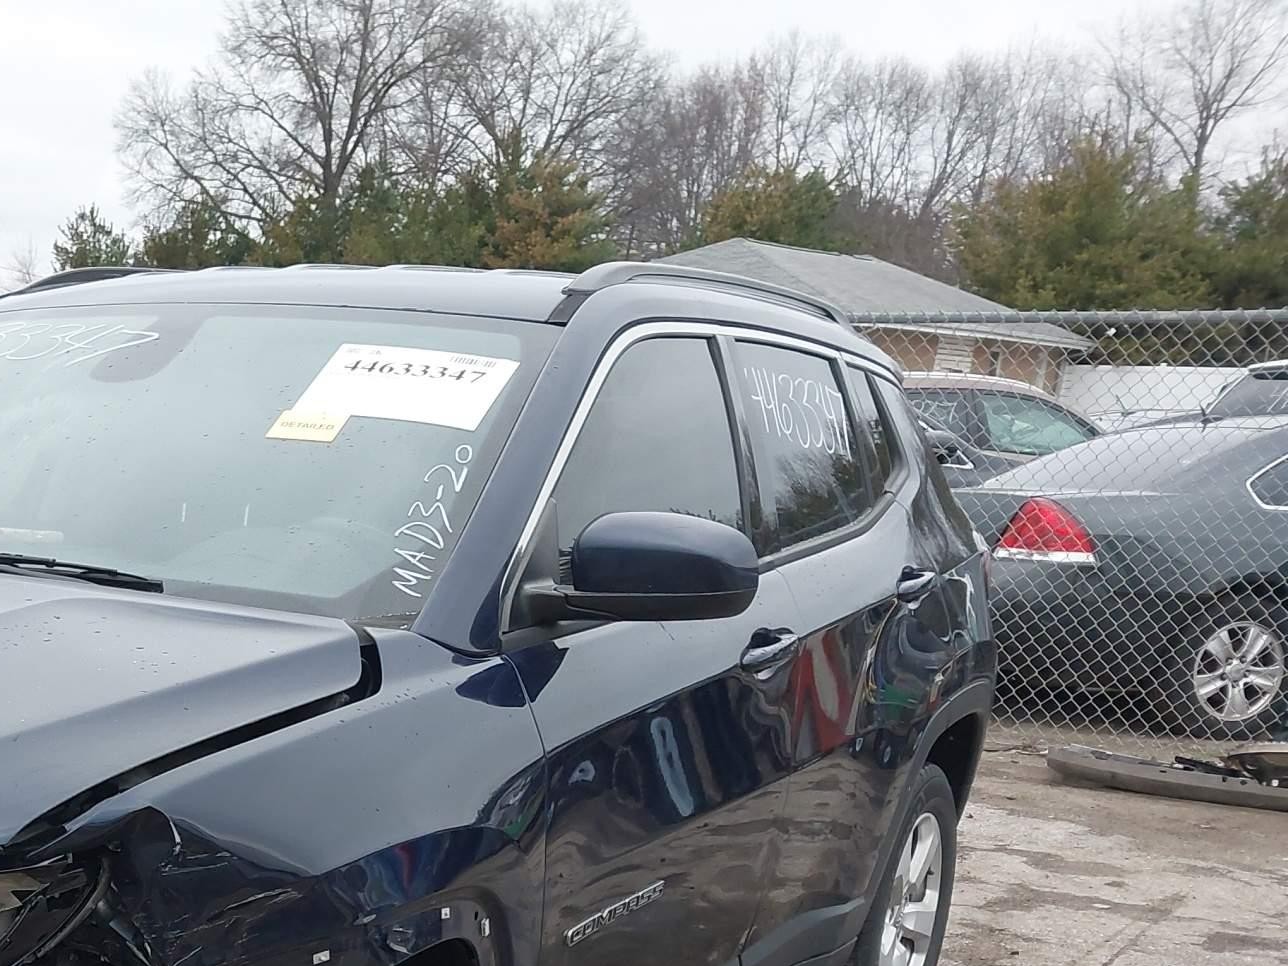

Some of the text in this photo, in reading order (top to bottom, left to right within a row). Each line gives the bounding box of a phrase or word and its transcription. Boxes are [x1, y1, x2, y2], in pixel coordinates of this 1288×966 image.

[344, 359, 487, 383] 44633347
[280, 421, 335, 430] DETAILED
[565, 880, 666, 947] COMPASS
